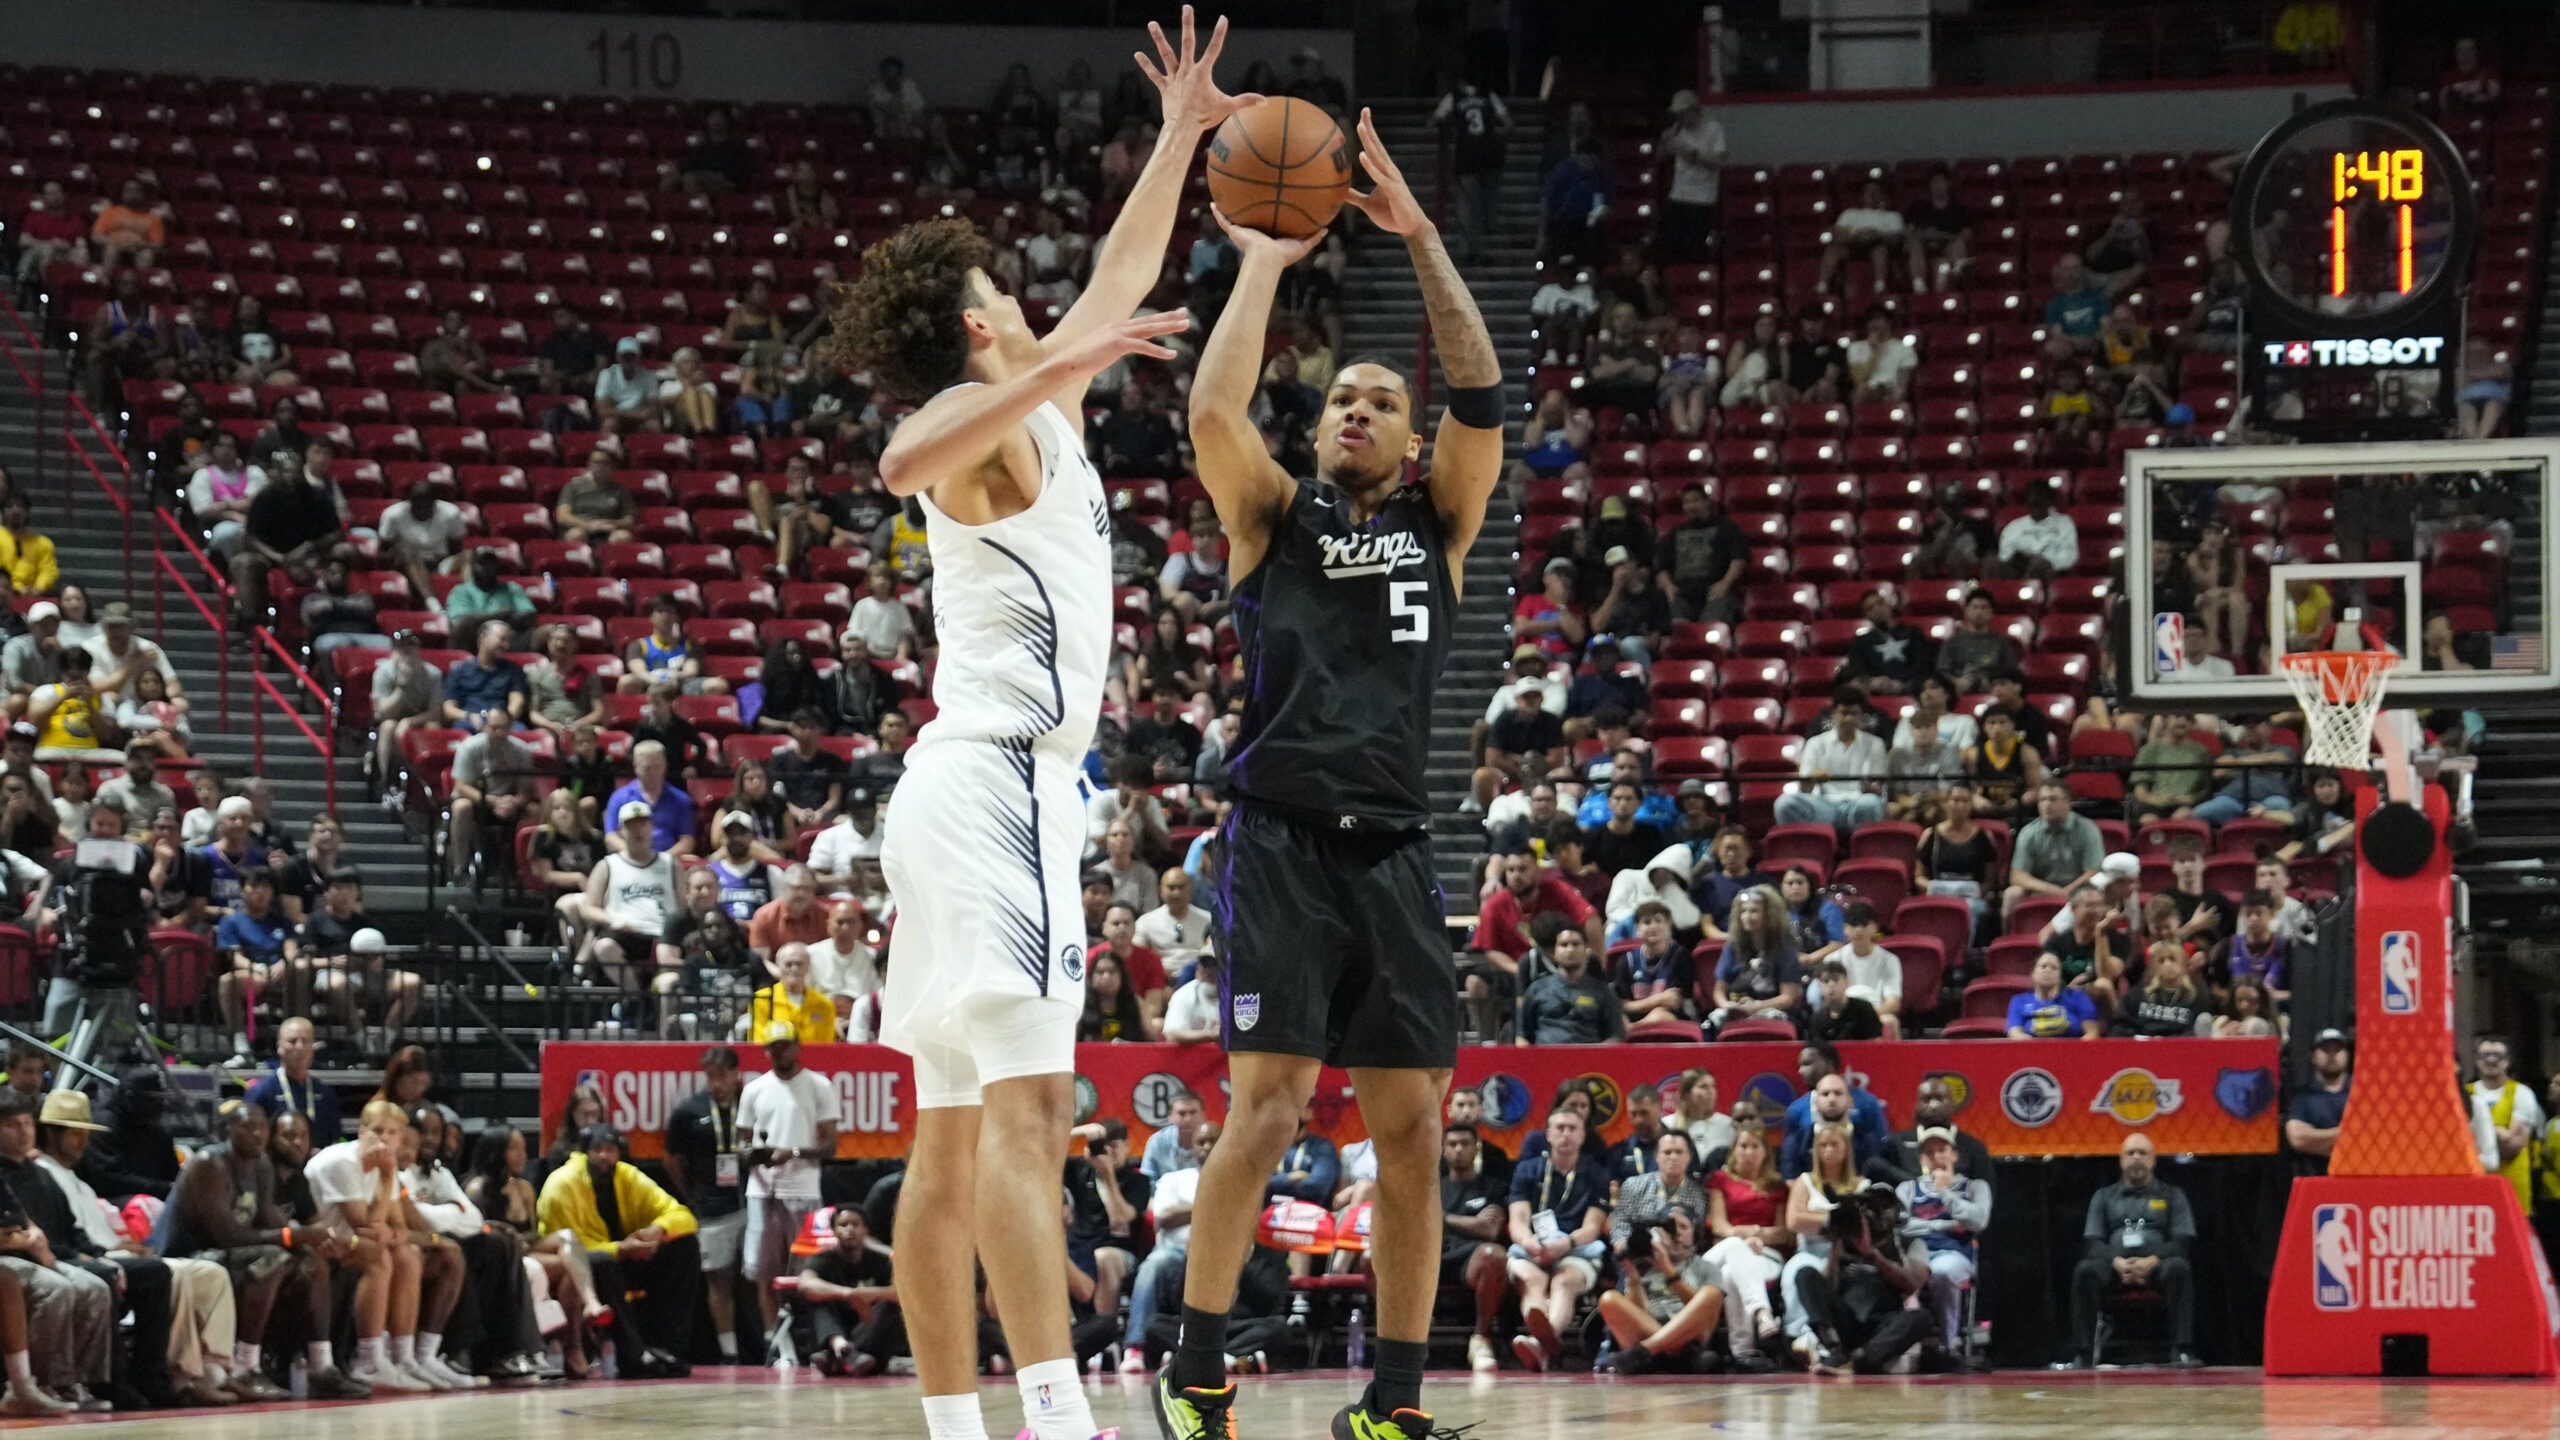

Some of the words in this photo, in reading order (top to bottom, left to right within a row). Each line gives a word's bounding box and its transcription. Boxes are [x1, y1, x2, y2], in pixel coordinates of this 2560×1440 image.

[587, 30, 682, 88] 110
[2334, 149, 2423, 201] 1:48
[2332, 203, 2413, 297] 11
[2312, 337, 2444, 366] TISSOT
[1317, 531, 1427, 577] Kings
[1389, 581, 1429, 642] 5
[1153, 1081, 1169, 1119] B
[2369, 1205, 2496, 1257] SUMMER
[2369, 1257, 2477, 1310] LEAGUE
